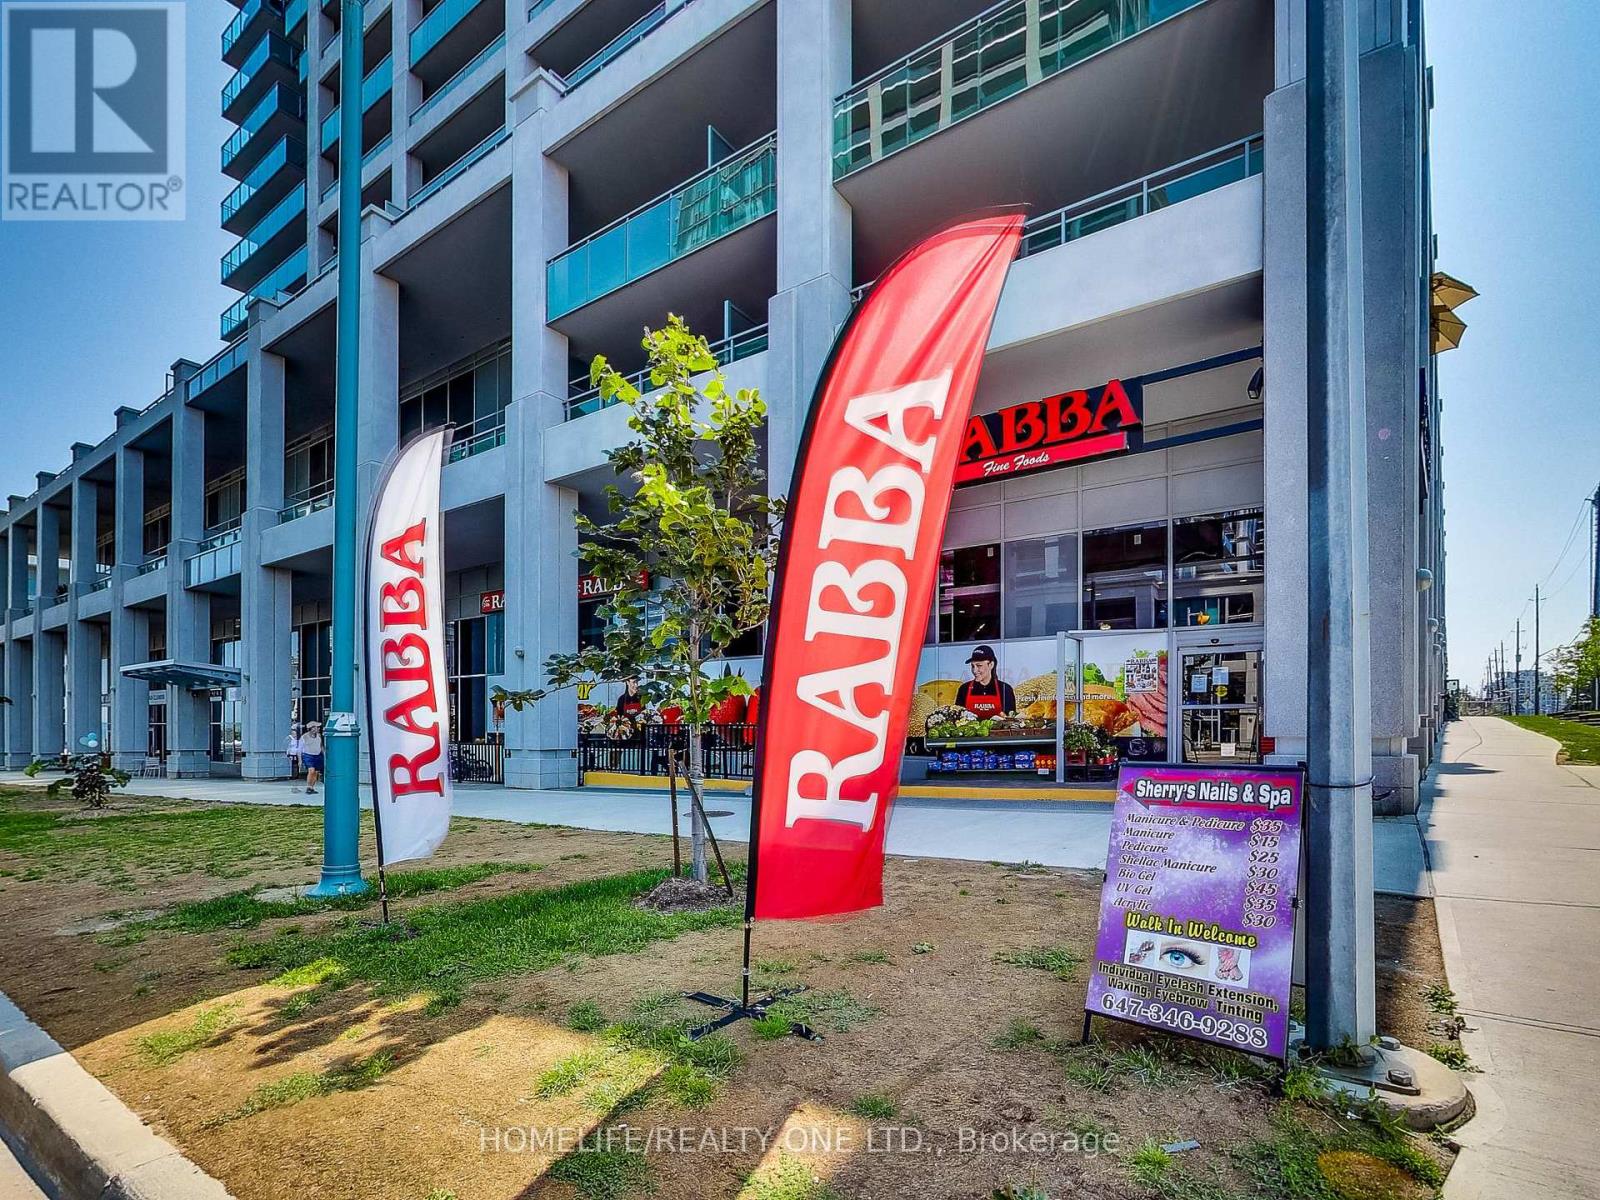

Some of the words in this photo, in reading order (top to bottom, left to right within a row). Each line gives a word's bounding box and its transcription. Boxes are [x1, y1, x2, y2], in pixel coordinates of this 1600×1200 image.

[983, 461, 1010, 476] Fine
[1013, 452, 1050, 471] Foods
[785, 368, 953, 833] RABBA
[379, 517, 445, 804] RABBA
[1136, 779, 1196, 802] Sherry's
[1199, 781, 1238, 801] Nails
[1242, 784, 1255, 803] &
[1259, 784, 1292, 809] Spa
[1124, 813, 1176, 826] Manicure
[1178, 816, 1189, 825] &
[1192, 816, 1245, 831] Pedicure
[1250, 818, 1282, 833] $35
[1123, 827, 1175, 840] Manicure
[1249, 834, 1279, 848] $15
[1121, 840, 1168, 853] Pedicure
[1120, 855, 1160, 867] Shellac
[1160, 858, 1217, 874] Manicure
[1248, 850, 1279, 864] $25
[1118, 868, 1136, 880] Bio
[1136, 869, 1156, 882] Gel
[1247, 865, 1278, 880] $30
[1116, 882, 1134, 893] UV
[1134, 884, 1152, 896] Gel
[1246, 881, 1277, 896] $45
[1113, 897, 1152, 912] Acrylic
[1243, 897, 1277, 912] $35
[1242, 912, 1276, 928] $30
[1126, 912, 1163, 931] Walk
[1167, 918, 1184, 935] In
[1188, 921, 1257, 948] Welcome
[1099, 962, 1153, 983] Individual
[1157, 972, 1204, 994] Eyelash
[1208, 984, 1279, 1014] Extension,
[1108, 976, 1151, 998] Waxing,
[1155, 988, 1208, 1010] Eyebrow
[1216, 1000, 1263, 1025] Tinting
[1102, 993, 1268, 1048] 647-346-9288
